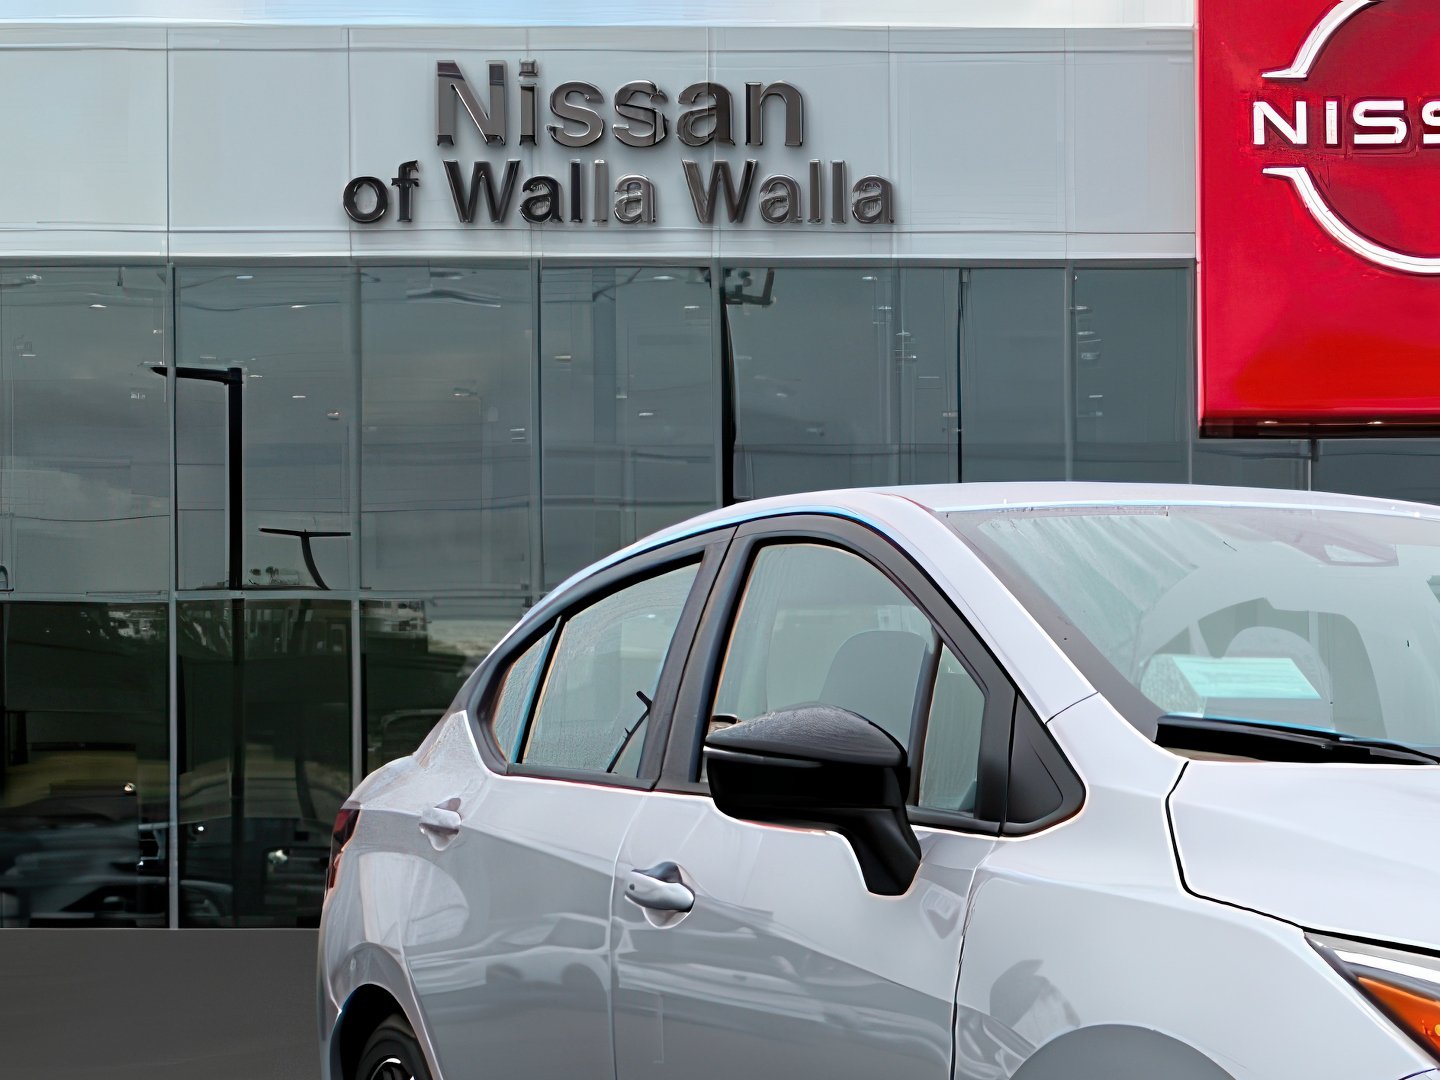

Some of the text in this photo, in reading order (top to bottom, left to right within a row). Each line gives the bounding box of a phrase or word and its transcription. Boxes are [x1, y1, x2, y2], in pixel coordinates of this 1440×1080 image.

[436, 59, 804, 147] Nissan
[342, 158, 896, 224] of Walla Walla
